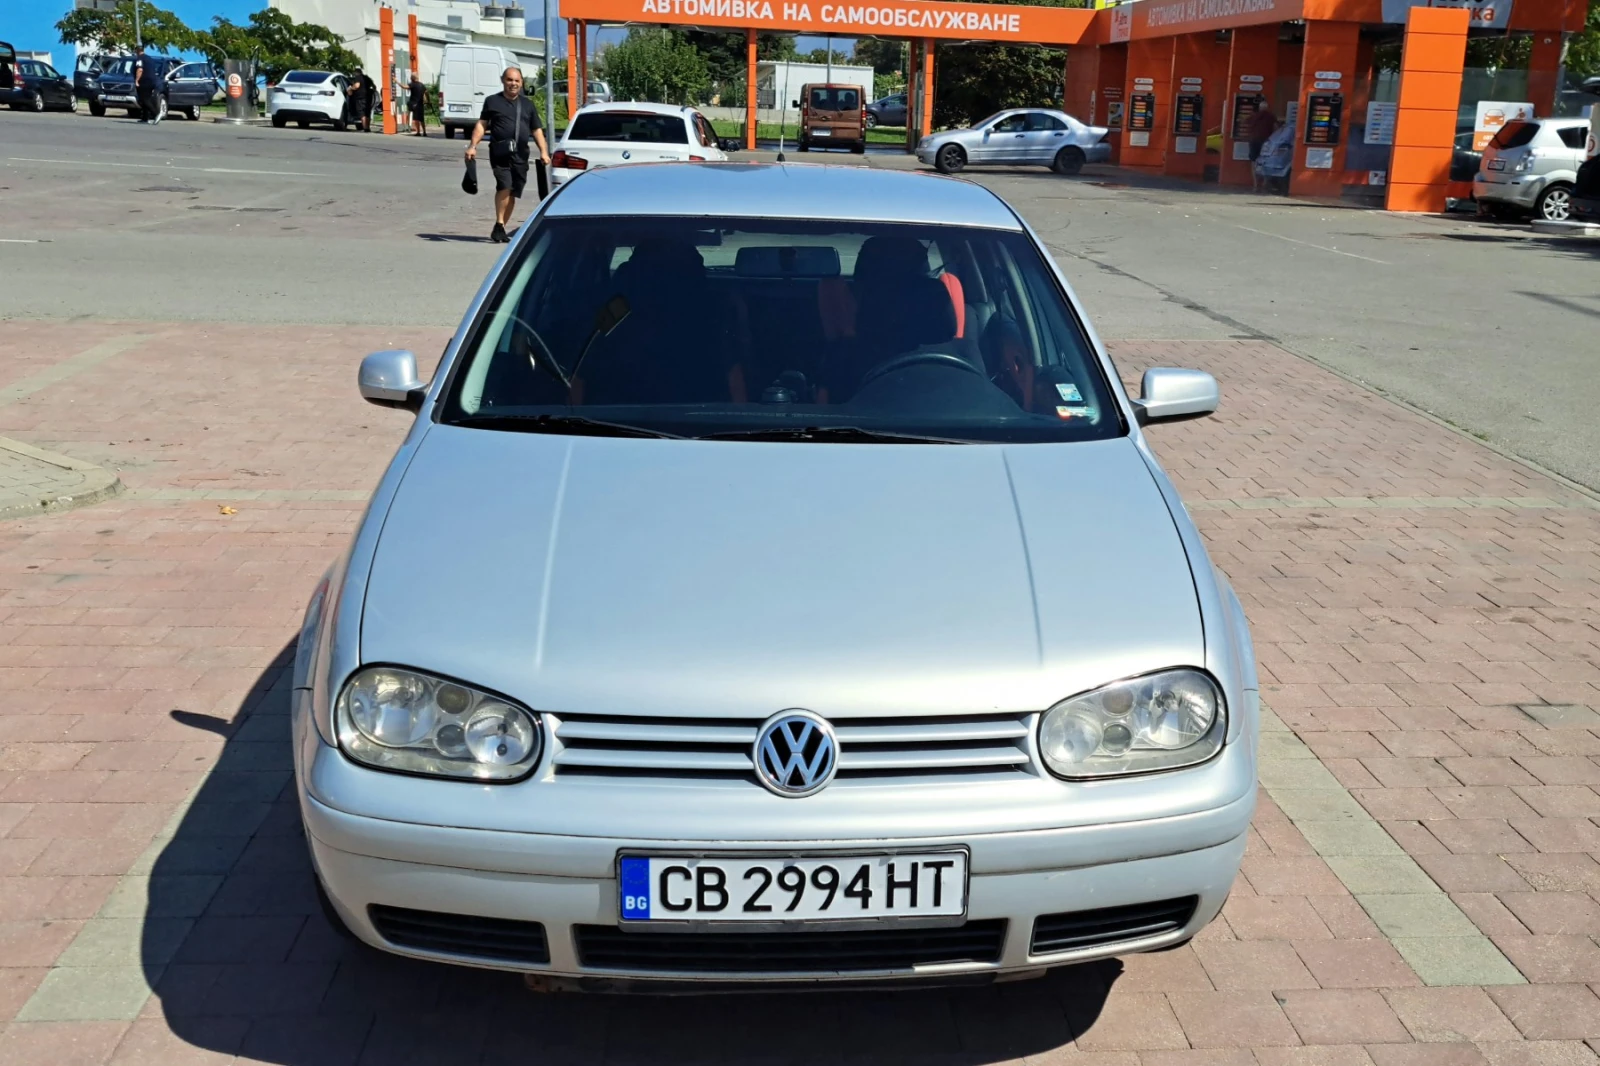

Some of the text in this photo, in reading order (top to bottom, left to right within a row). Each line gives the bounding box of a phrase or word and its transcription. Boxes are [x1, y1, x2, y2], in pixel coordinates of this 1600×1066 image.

[642, 0, 1021, 32] АВТОМИВКА НА САМООБСЛУЖВАНЕ
[659, 861, 955, 912] CB 2994 HT
[625, 896, 647, 910] BG
